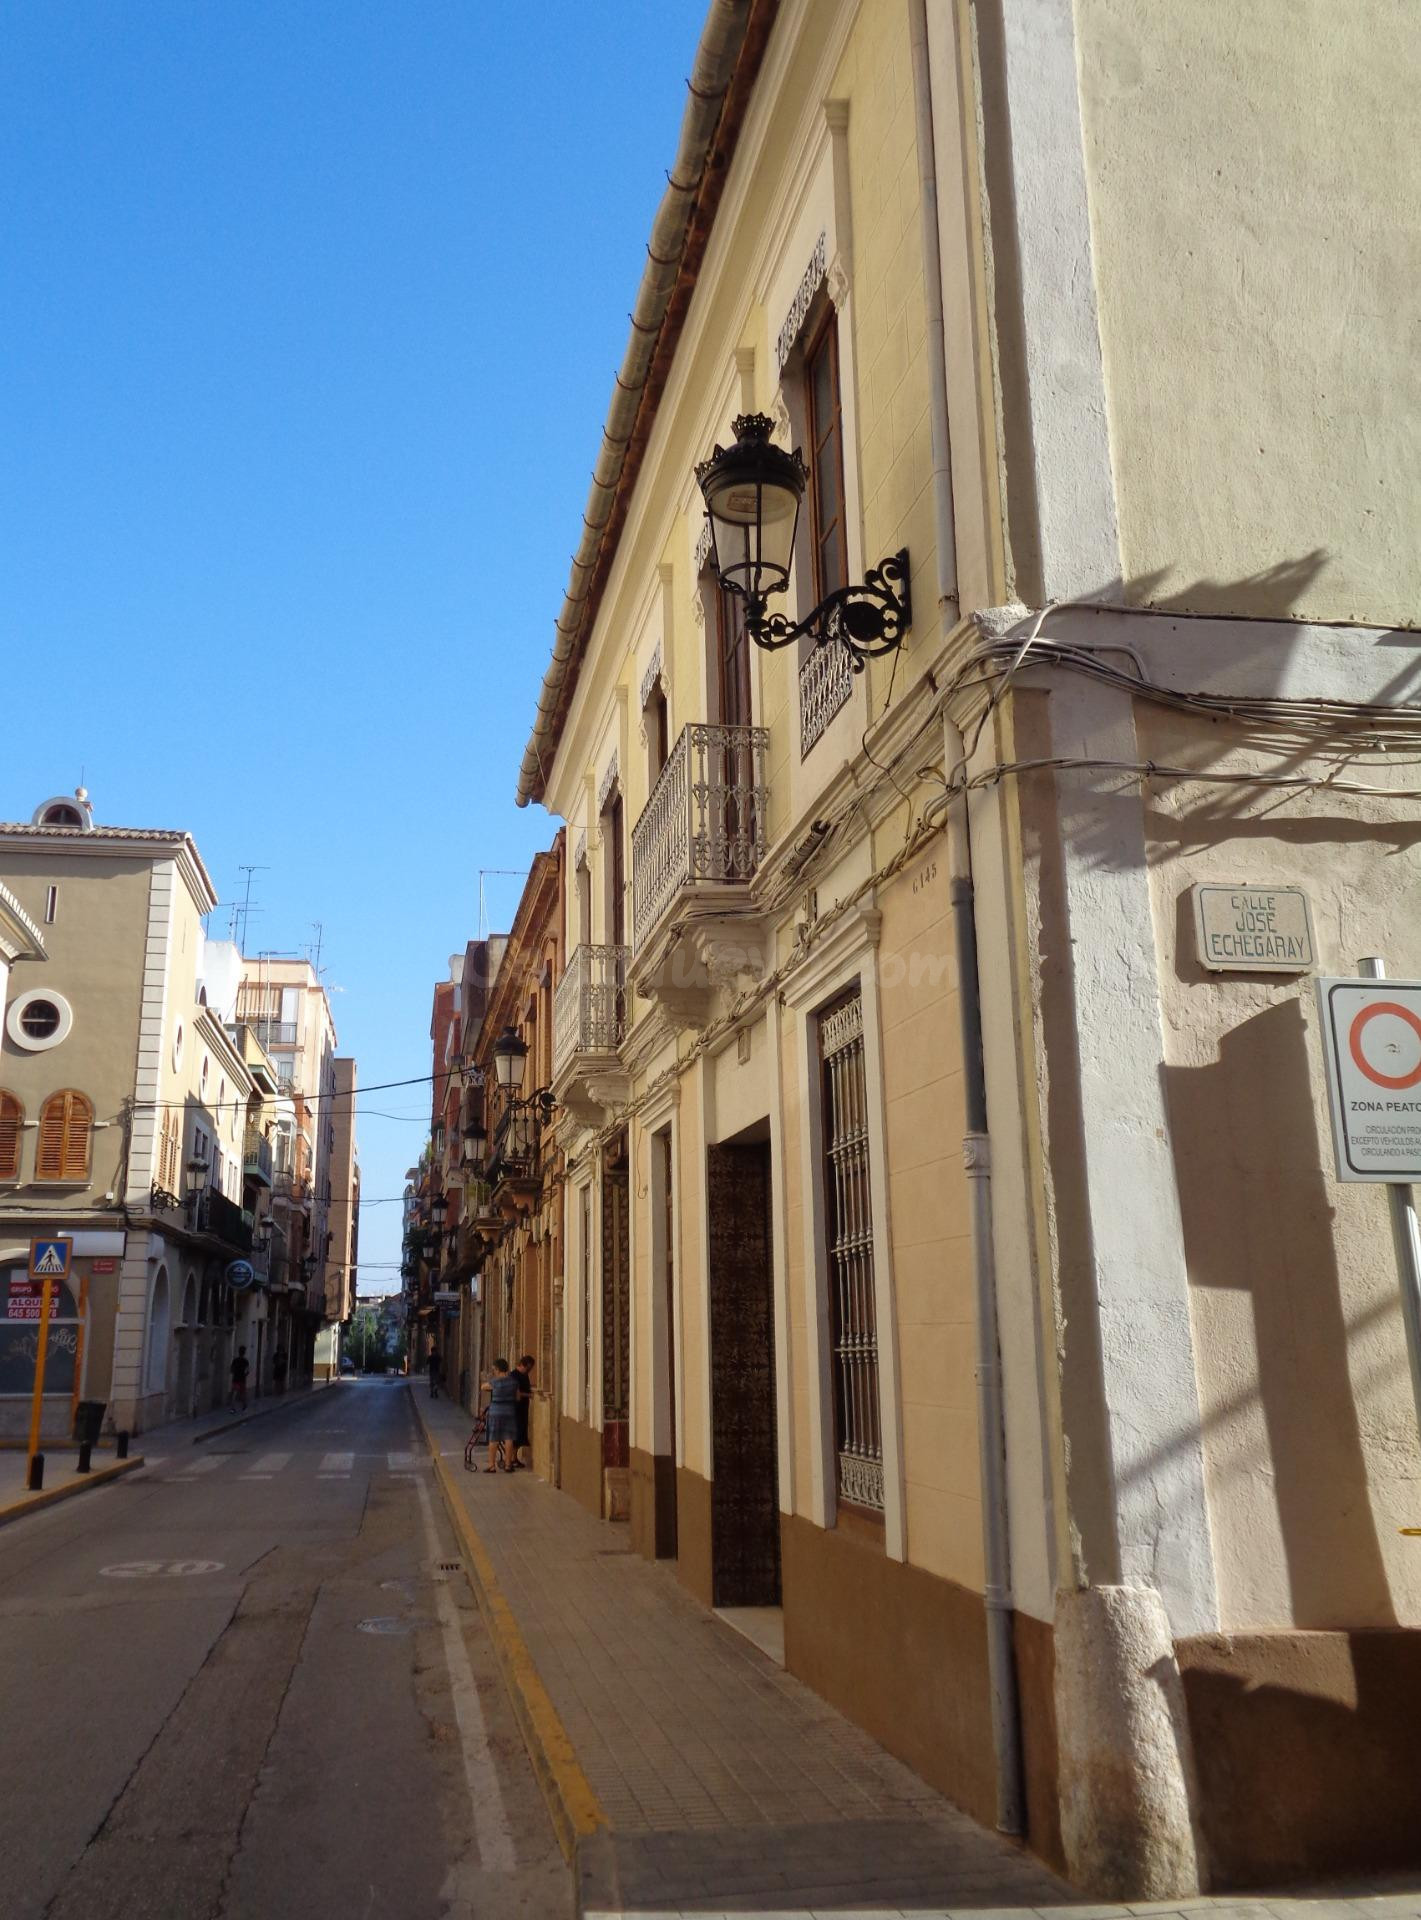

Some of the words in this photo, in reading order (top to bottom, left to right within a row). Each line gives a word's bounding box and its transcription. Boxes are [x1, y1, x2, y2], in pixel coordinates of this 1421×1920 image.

[1231, 895, 1276, 910] CALLE
[1236, 911, 1277, 933] JOSE
[1211, 933, 1304, 958] ECHEGARAY
[1351, 1101, 1384, 1111] ZONA
[10, 1298, 56, 1306] ALQUIA
